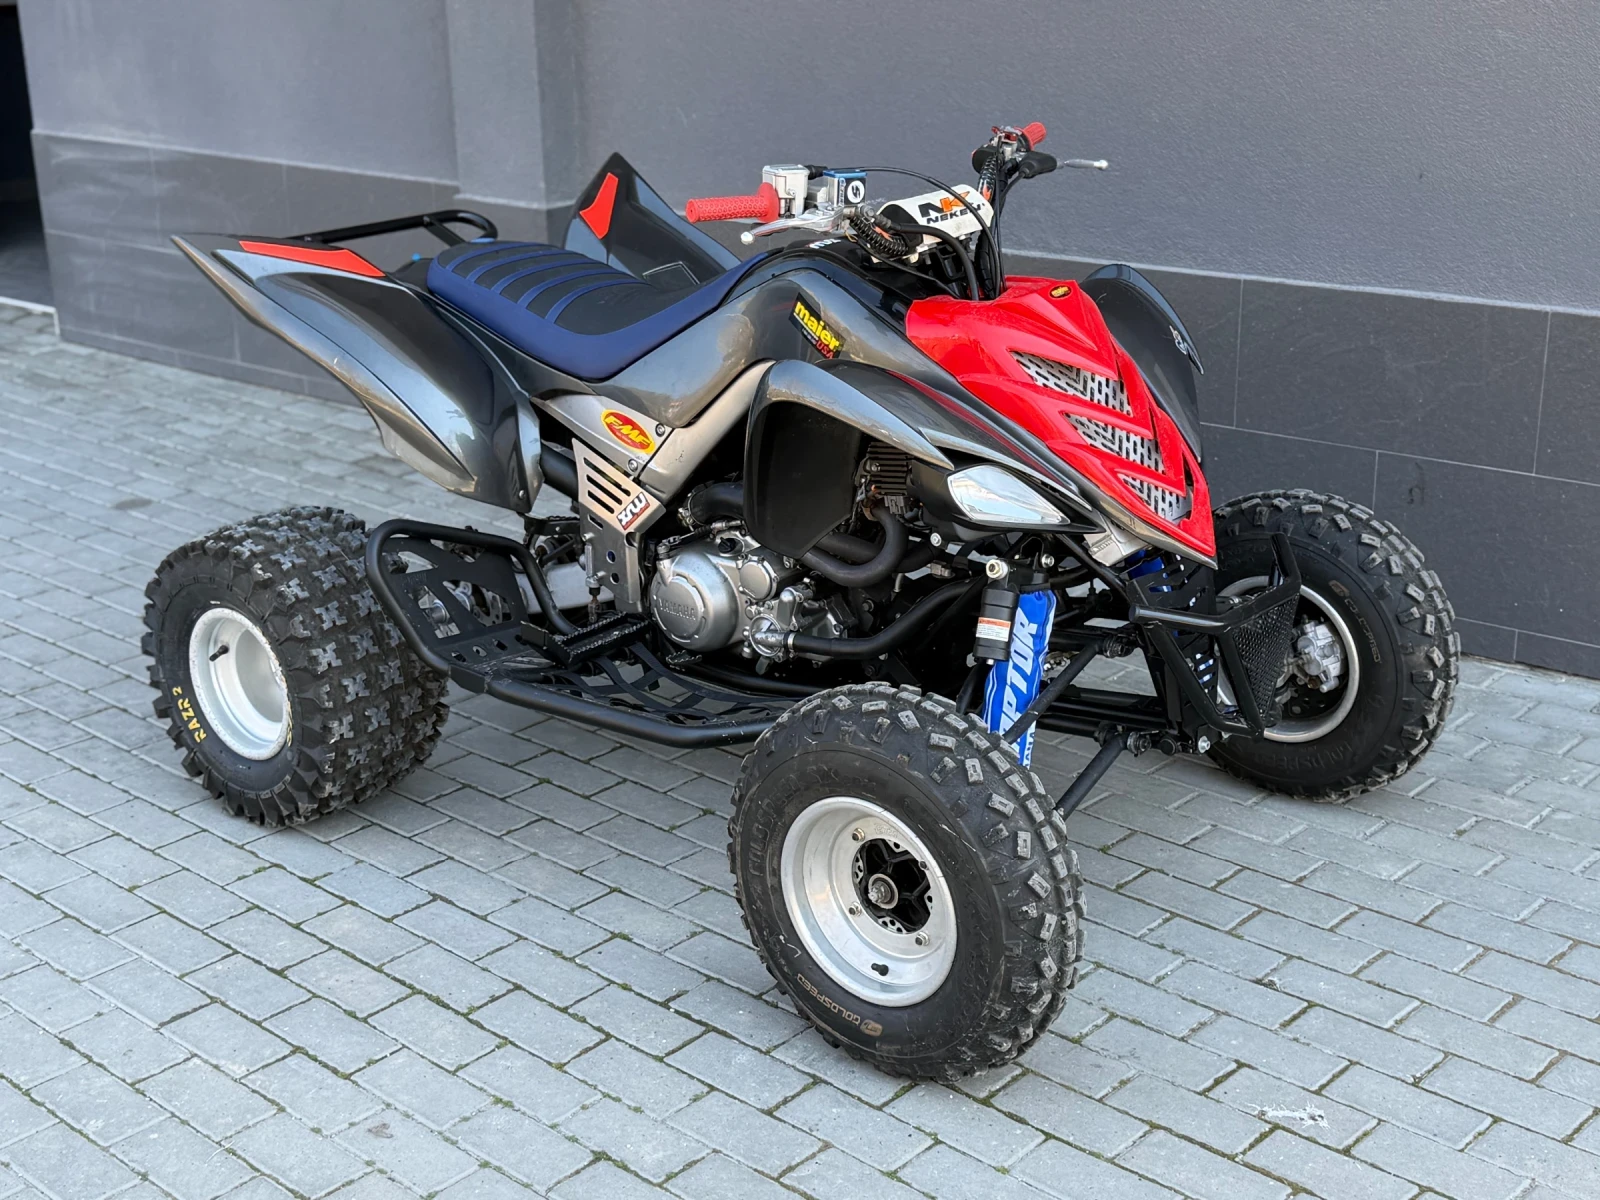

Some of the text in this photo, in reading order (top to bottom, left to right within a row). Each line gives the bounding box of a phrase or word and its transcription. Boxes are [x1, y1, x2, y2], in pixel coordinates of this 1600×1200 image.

[794, 301, 840, 351] maier
[604, 415, 653, 445] FMF
[658, 597, 697, 621] YAMAHA
[172, 686, 207, 743] RAZR 2
[796, 973, 861, 1026] GOLDSPEED
